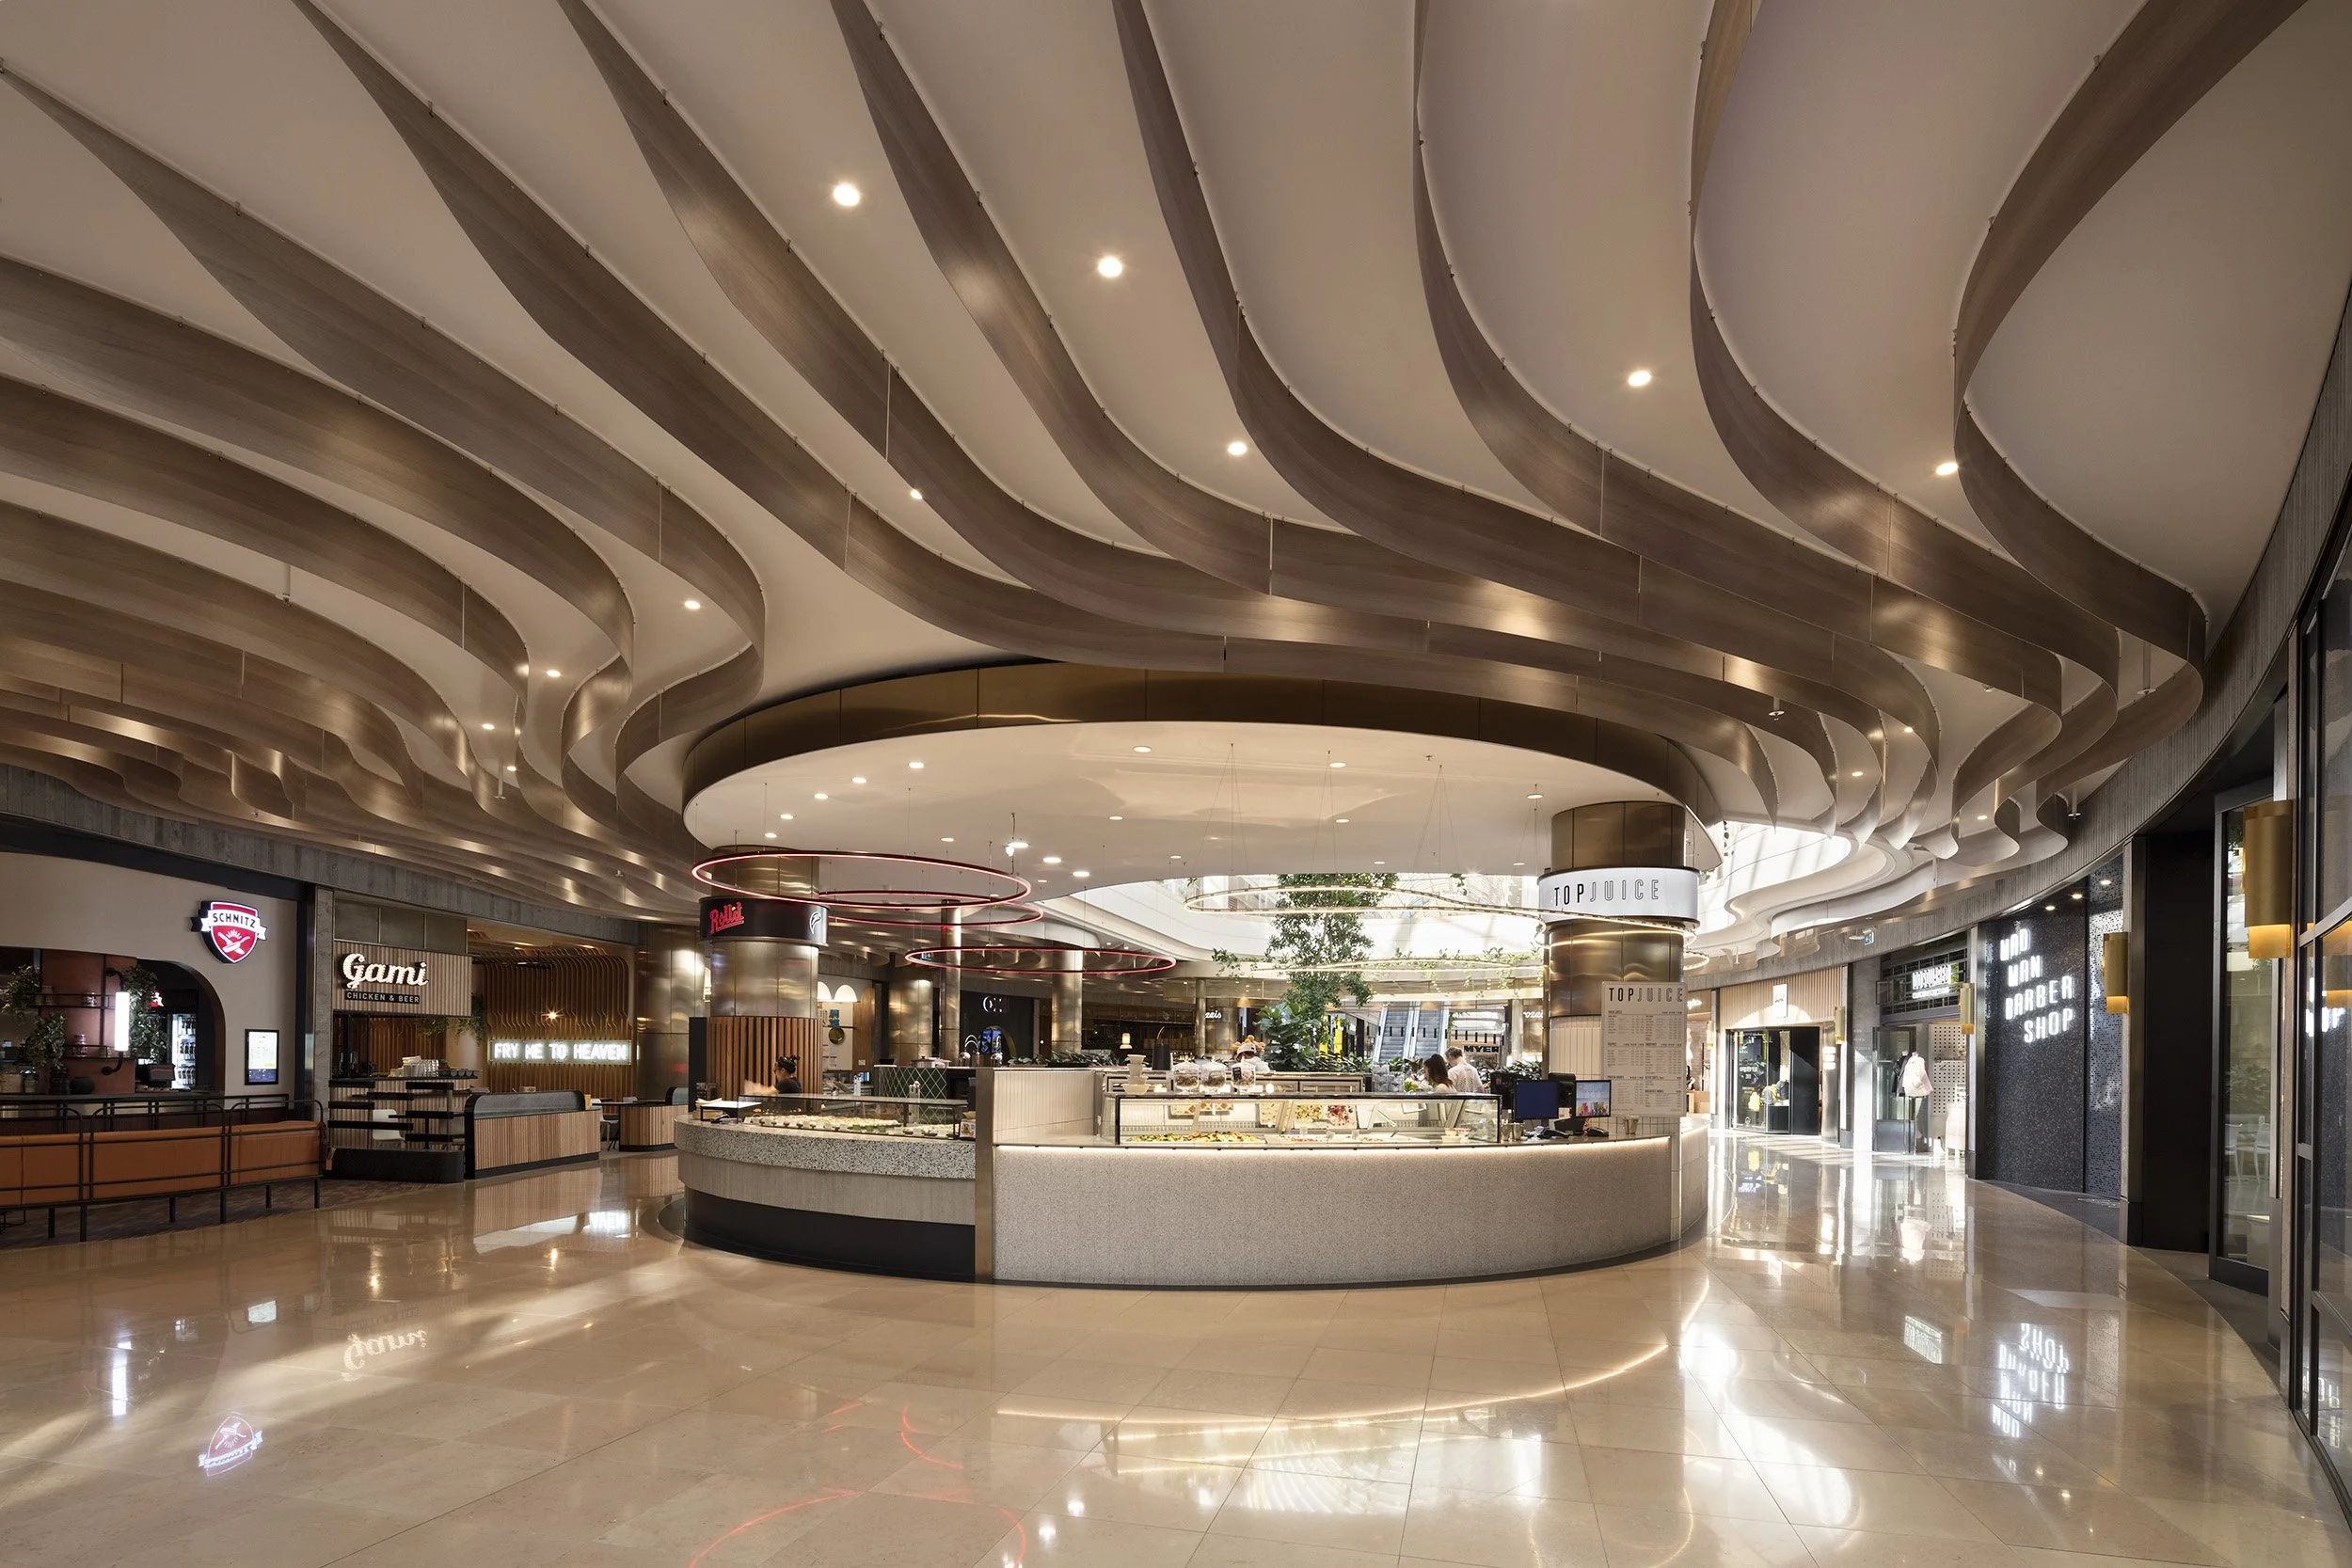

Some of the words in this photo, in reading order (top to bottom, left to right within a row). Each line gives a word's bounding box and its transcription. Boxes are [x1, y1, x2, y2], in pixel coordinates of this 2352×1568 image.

[212, 912, 257, 928] SCHNITZ
[2000, 927, 2030, 960] MAD
[342, 953, 429, 990] Gami
[2008, 955, 2042, 987] MAN
[346, 991, 386, 1001] CHICKEN
[2005, 975, 2074, 1021] BARBER
[2024, 1007, 2074, 1043] SHOP
[494, 1042, 518, 1059] FRY
[524, 1043, 543, 1059] ME
[548, 1043, 568, 1060] TO
[573, 1043, 627, 1060] HEAVEN
